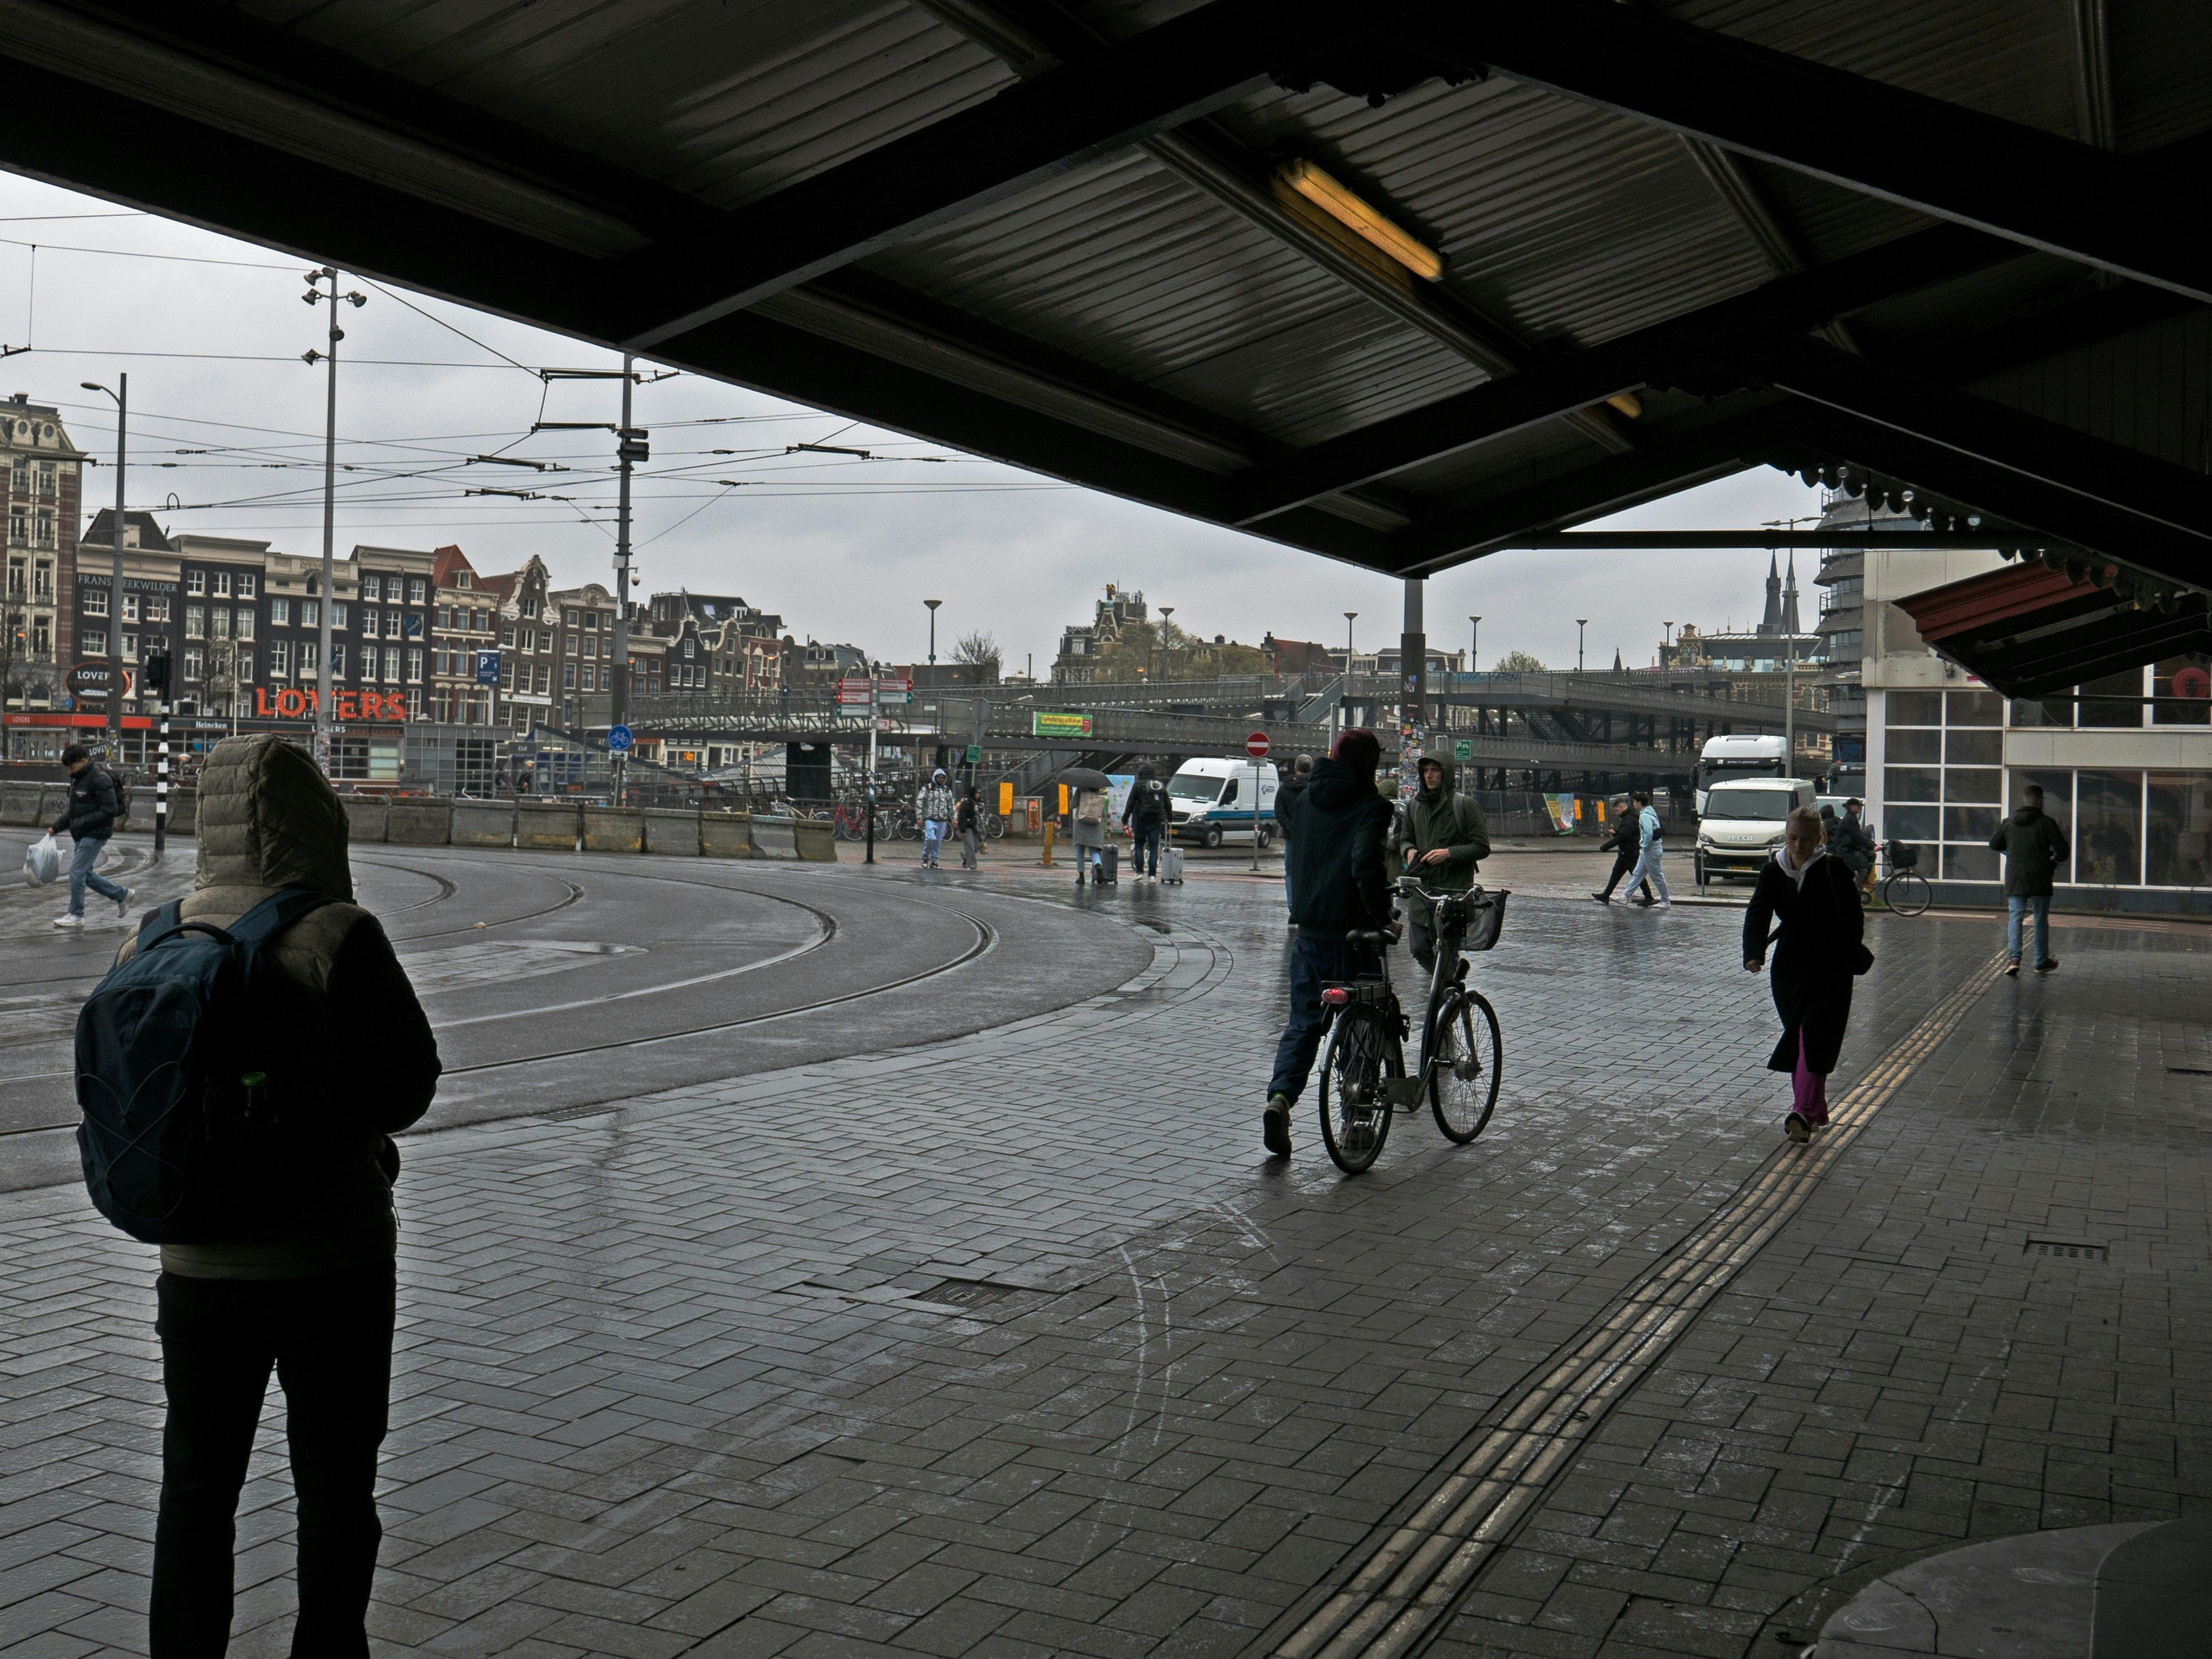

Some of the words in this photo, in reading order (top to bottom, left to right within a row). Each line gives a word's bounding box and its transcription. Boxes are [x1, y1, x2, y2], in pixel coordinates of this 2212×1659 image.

[78, 574, 112, 586] FRANS
[123, 579, 177, 592] EEKWILDER
[480, 657, 488, 668] P
[255, 687, 405, 721] LOVERS
